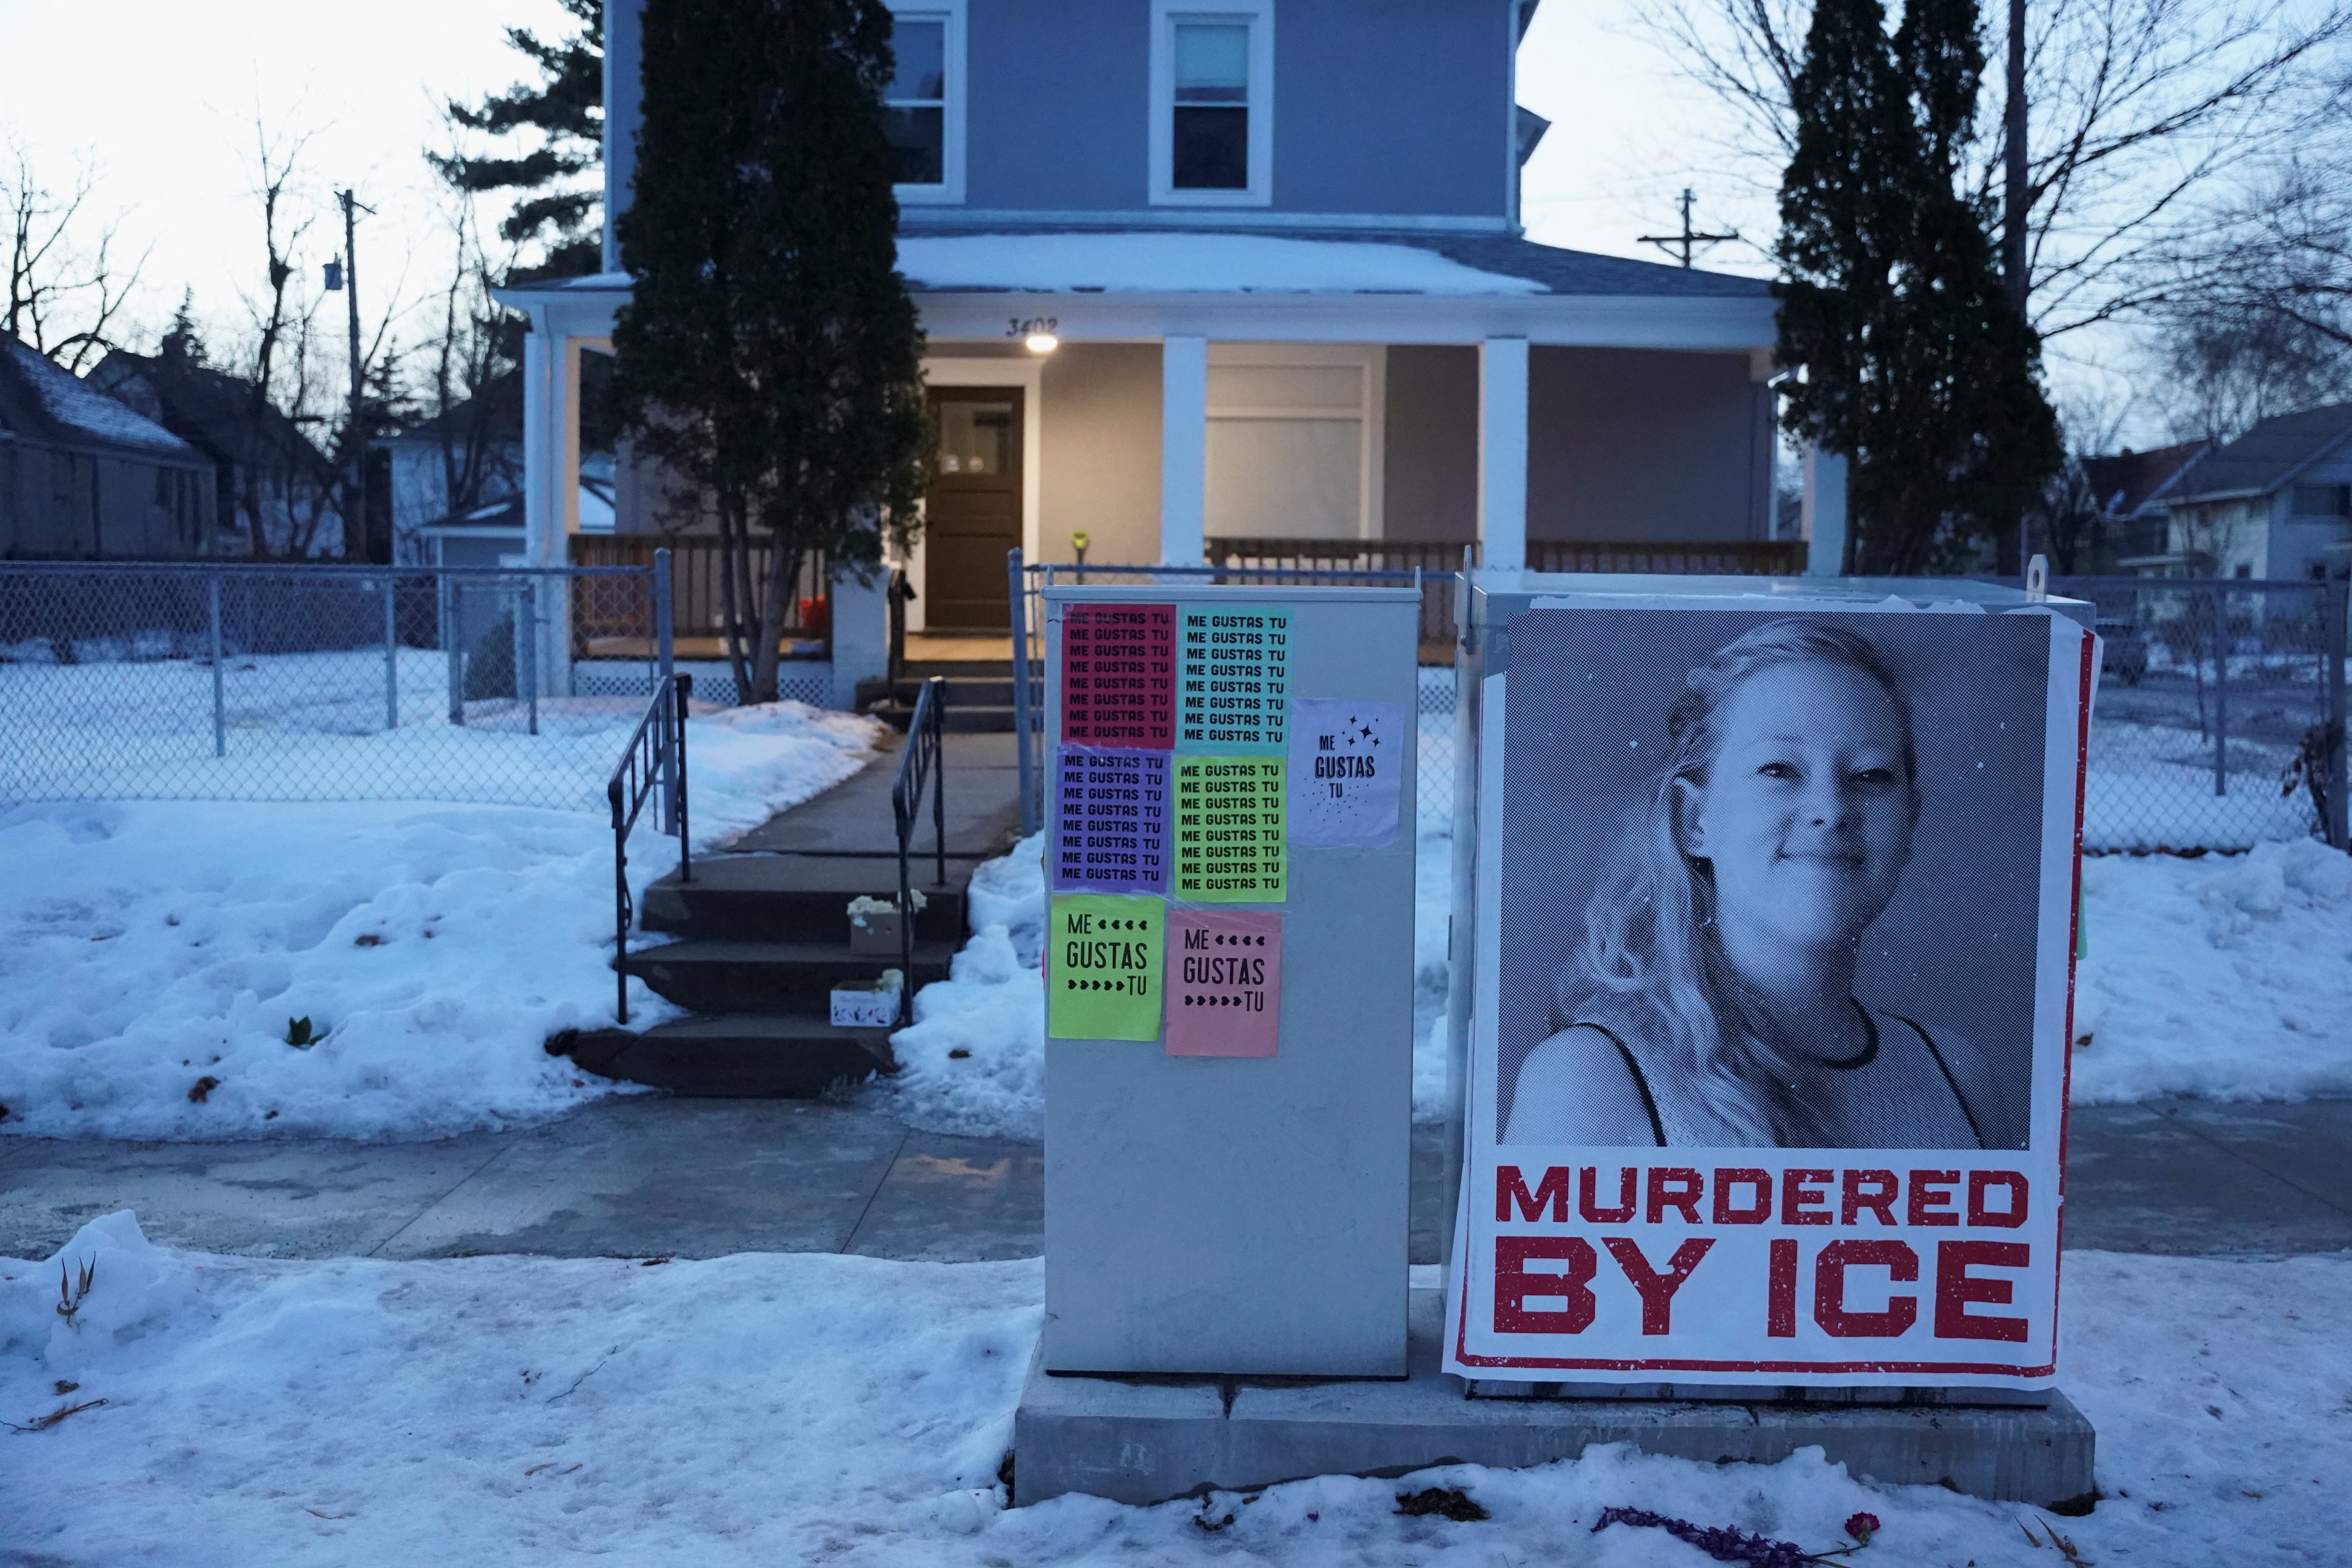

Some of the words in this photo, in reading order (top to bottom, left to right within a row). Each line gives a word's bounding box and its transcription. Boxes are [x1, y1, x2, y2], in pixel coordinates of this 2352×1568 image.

[1070, 613, 1089, 624] ME
[1095, 613, 1146, 624] GUSTAS
[1152, 613, 1169, 624] TU
[1188, 616, 1206, 627] ME
[1212, 616, 1263, 628] GUSTAS
[1269, 618, 1286, 629] TU
[1070, 629, 1089, 640] ME
[1095, 629, 1145, 640] GUSTAS
[1152, 629, 1168, 640] TU
[1188, 632, 1206, 643] ME
[1212, 632, 1262, 644] GUSTAS
[1269, 634, 1285, 645] TU
[1070, 645, 1089, 656] ME
[1095, 645, 1145, 656] GUSTAS
[1152, 645, 1168, 657] TU
[1187, 648, 1206, 659] ME
[1212, 649, 1262, 661] GUSTAS
[1268, 650, 1285, 661] TU
[1070, 661, 1089, 672] ME
[1094, 661, 1144, 673] GUSTAS
[1151, 662, 1168, 673] TU
[1187, 665, 1205, 675] ME
[1211, 665, 1261, 677] GUSTAS
[1268, 667, 1284, 677] TU
[1070, 678, 1089, 688] ME
[1094, 677, 1144, 689] GUSTAS
[1151, 678, 1168, 689] TU
[1186, 681, 1205, 692] ME
[1211, 681, 1261, 693] GUSTAS
[1267, 683, 1284, 693] TU
[1070, 694, 1088, 705] ME
[1094, 694, 1144, 705] GUSTAS
[1151, 694, 1168, 705] TU
[1186, 697, 1204, 708] ME
[1210, 697, 1261, 709] GUSTAS
[1267, 699, 1283, 710] TU
[1070, 710, 1088, 721] ME
[1094, 710, 1144, 721] GUSTAS
[1151, 711, 1168, 721] TU
[1185, 713, 1204, 724] ME
[1210, 714, 1260, 725] GUSTAS
[1266, 716, 1283, 726] TU
[1069, 726, 1088, 737] ME
[1094, 726, 1144, 737] GUSTAS
[1151, 726, 1167, 738] TU
[1185, 729, 1203, 740] ME
[1209, 730, 1259, 741] GUSTAS
[1266, 732, 1282, 742] TU
[1319, 735, 1335, 750] ME
[1065, 756, 1083, 766] ME
[1089, 756, 1140, 768] GUSTAS
[1146, 758, 1163, 769] TU
[1315, 756, 1375, 779] GUSTAS
[1181, 766, 1200, 776] ME
[1206, 765, 1255, 776] GUSTAS
[1262, 765, 1278, 776] TU
[1065, 772, 1083, 782] ME
[1089, 772, 1139, 784] GUSTAS
[1145, 774, 1162, 785] TU
[1181, 782, 1200, 793] ME
[1206, 781, 1255, 792] GUSTAS
[1262, 781, 1278, 792] TU
[1329, 783, 1343, 798] TU
[1065, 788, 1083, 798] ME
[1089, 788, 1138, 800] GUSTAS
[1145, 790, 1161, 801] TU
[1182, 798, 1200, 809] ME
[1206, 798, 1256, 809] GUSTAS
[1262, 797, 1279, 808] TU
[1064, 804, 1082, 814] ME
[1088, 804, 1138, 816] GUSTAS
[1144, 806, 1161, 817] TU
[1182, 815, 1200, 825] ME
[1206, 814, 1256, 825] GUSTAS
[1262, 814, 1279, 824] TU
[1064, 820, 1082, 831] ME
[1088, 820, 1137, 832] GUSTAS
[1144, 822, 1160, 833] TU
[1182, 831, 1200, 841] ME
[1206, 830, 1256, 841] GUSTAS
[1263, 830, 1279, 841] TU
[1063, 836, 1081, 847] ME
[1088, 836, 1137, 849] GUSTAS
[1144, 839, 1160, 850] TU
[1182, 847, 1200, 858] ME
[1207, 846, 1256, 857] GUSTAS
[1263, 846, 1279, 857] TU
[1063, 852, 1081, 863] ME
[1087, 852, 1136, 864] GUSTAS
[1143, 855, 1159, 866] TU
[1182, 863, 1200, 873] ME
[1207, 863, 1256, 873] GUSTAS
[1263, 862, 1279, 873] TU
[1063, 868, 1081, 878] ME
[1087, 868, 1136, 880] GUSTAS
[1143, 871, 1159, 881] TU
[1183, 879, 1200, 889] ME
[1207, 878, 1256, 889] GUSTAS
[1263, 878, 1279, 889] TU
[1068, 914, 1091, 934] ME
[1185, 929, 1209, 949] ME
[1067, 941, 1147, 969] GUSTAS
[1184, 957, 1264, 985] GUSTAS
[1127, 976, 1146, 995] TU
[1244, 991, 1263, 1011] TU
[1496, 1166, 2028, 1228] MURDERED
[1494, 1236, 1716, 1335] BY
[1768, 1239, 2030, 1342] ICE
